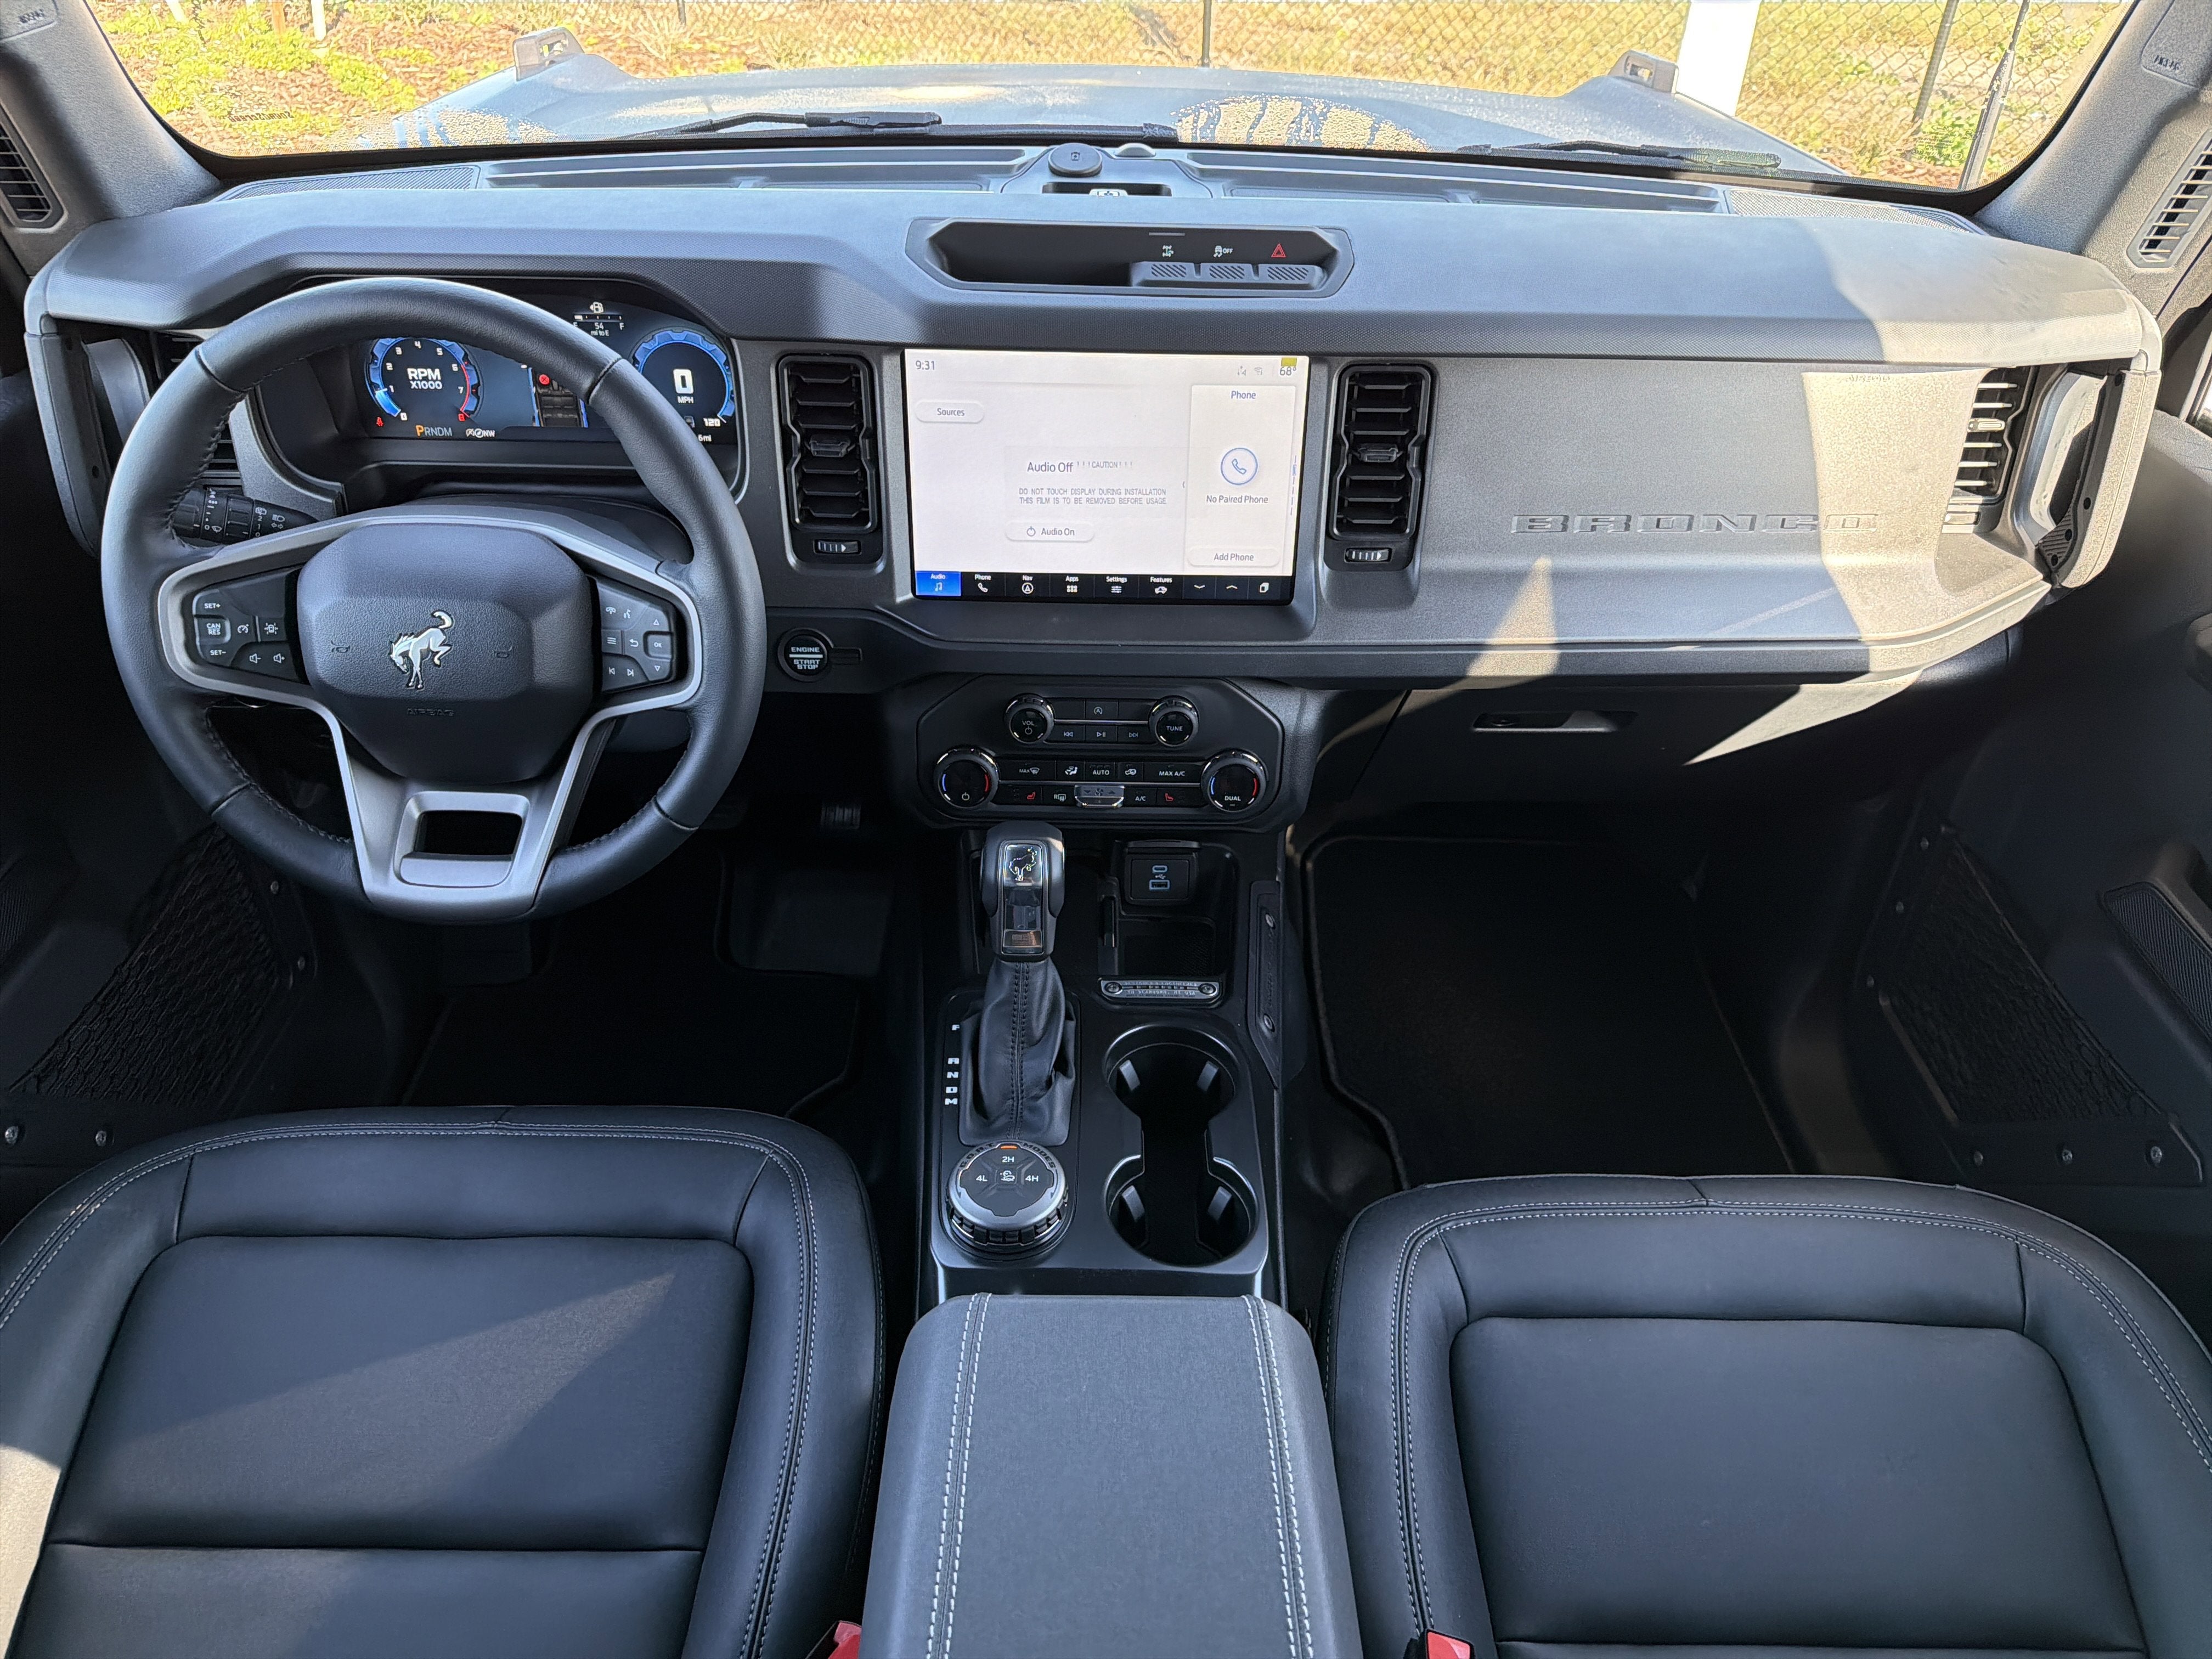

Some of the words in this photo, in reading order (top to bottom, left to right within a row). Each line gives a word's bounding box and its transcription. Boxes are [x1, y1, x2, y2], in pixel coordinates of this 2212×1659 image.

[415, 341, 421, 349] 4
[452, 363, 458, 371] 6
[915, 360, 935, 370] 9:31
[407, 368, 441, 380] RPM
[1279, 366, 1297, 376] 68°
[410, 381, 442, 390] X1000
[673, 369, 694, 394] 0
[1231, 390, 1256, 399] Phone
[678, 396, 694, 404] MPH
[936, 408, 965, 416] Sources
[400, 413, 408, 421] 0
[458, 413, 465, 421] 8
[703, 417, 721, 427] 120
[415, 425, 453, 437] PRNDM
[1027, 461, 1056, 472] Audio
[1058, 462, 1074, 472] Off
[1206, 495, 1217, 503] No
[1218, 495, 1243, 504] Paired
[1244, 495, 1268, 504] Phone
[1510, 514, 1879, 534] BRONCO
[1041, 528, 1063, 536] Audio
[1214, 552, 1229, 561] Add
[1230, 553, 1255, 561] Phone
[1023, 1142, 1056, 1169] MODES
